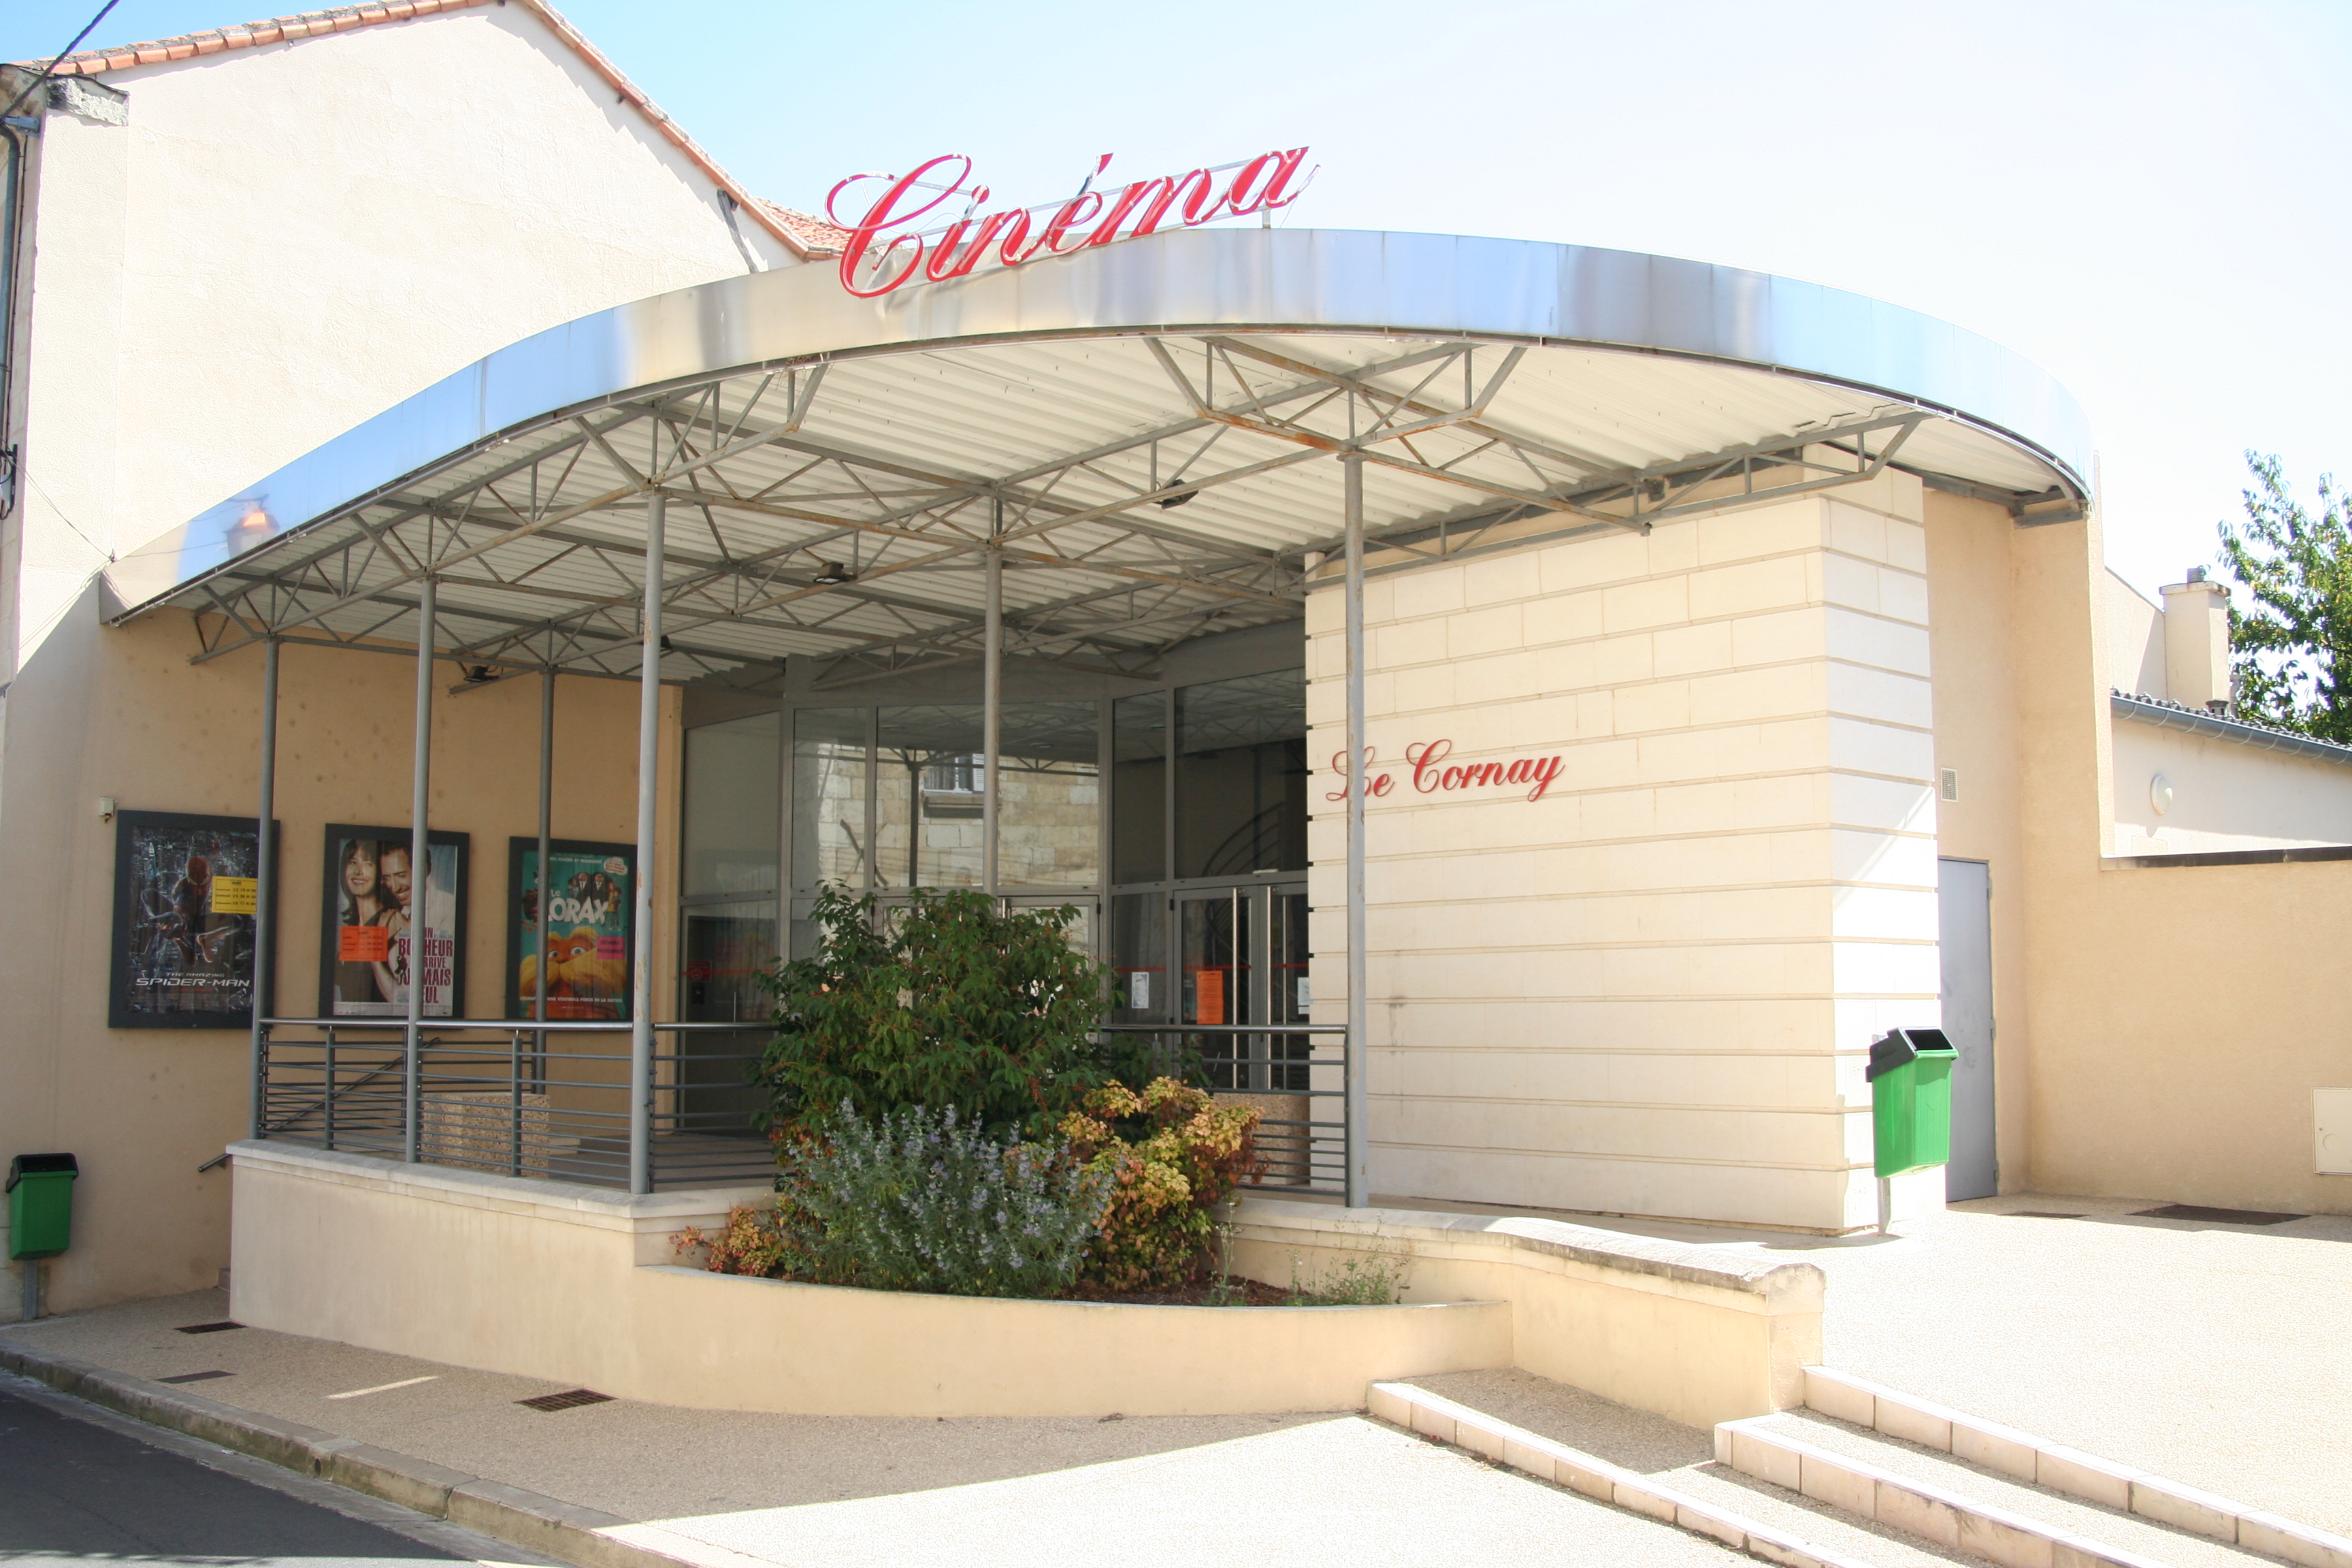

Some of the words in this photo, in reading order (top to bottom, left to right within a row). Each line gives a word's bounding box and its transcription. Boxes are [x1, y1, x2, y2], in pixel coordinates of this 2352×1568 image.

[824, 146, 1321, 298] Cinéma
[1326, 746, 1395, 802] Le
[1406, 738, 1566, 802] Cornay
[549, 896, 608, 924] ORAX
[399, 938, 453, 957] BOHEUR
[136, 978, 250, 987] SPIDER-MAN
[404, 968, 451, 986] JMAIS
